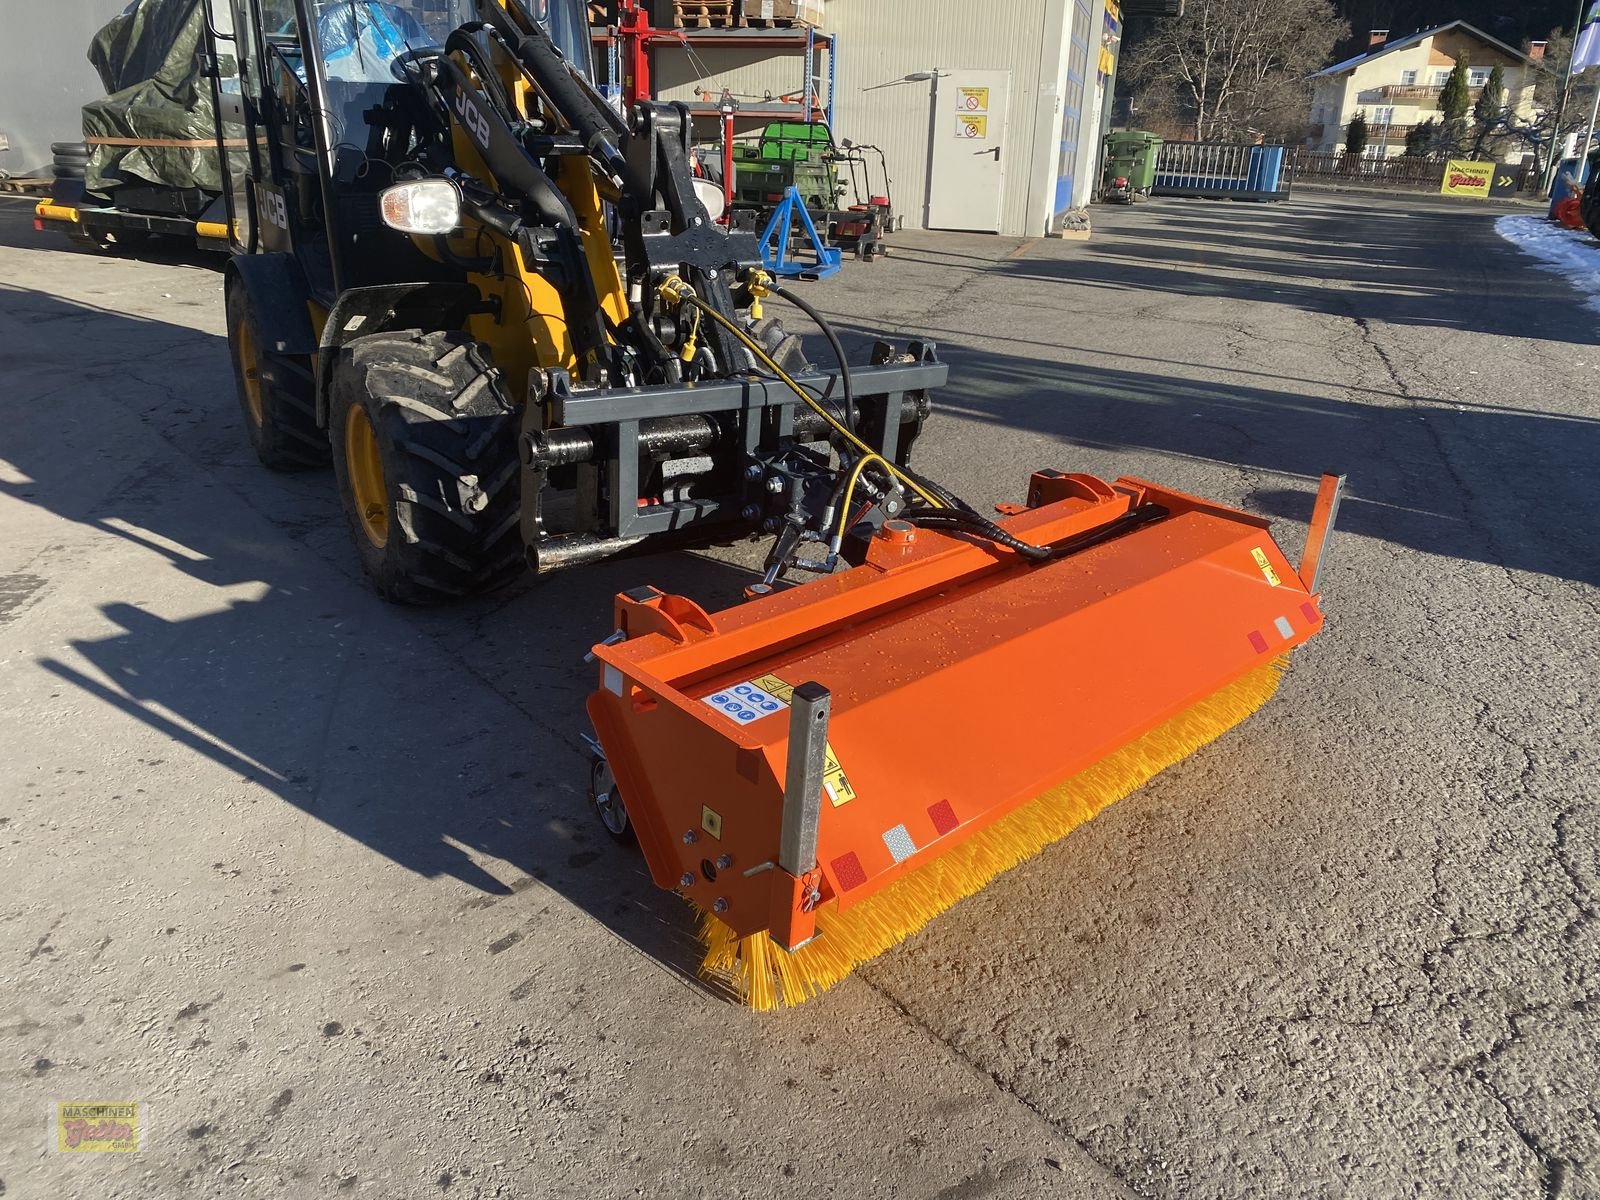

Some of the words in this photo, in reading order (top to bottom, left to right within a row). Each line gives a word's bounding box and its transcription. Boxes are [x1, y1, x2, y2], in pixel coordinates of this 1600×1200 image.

[455, 92, 490, 149] JCB
[1450, 167, 1489, 175] MASCHINEN
[259, 188, 287, 230] JCB
